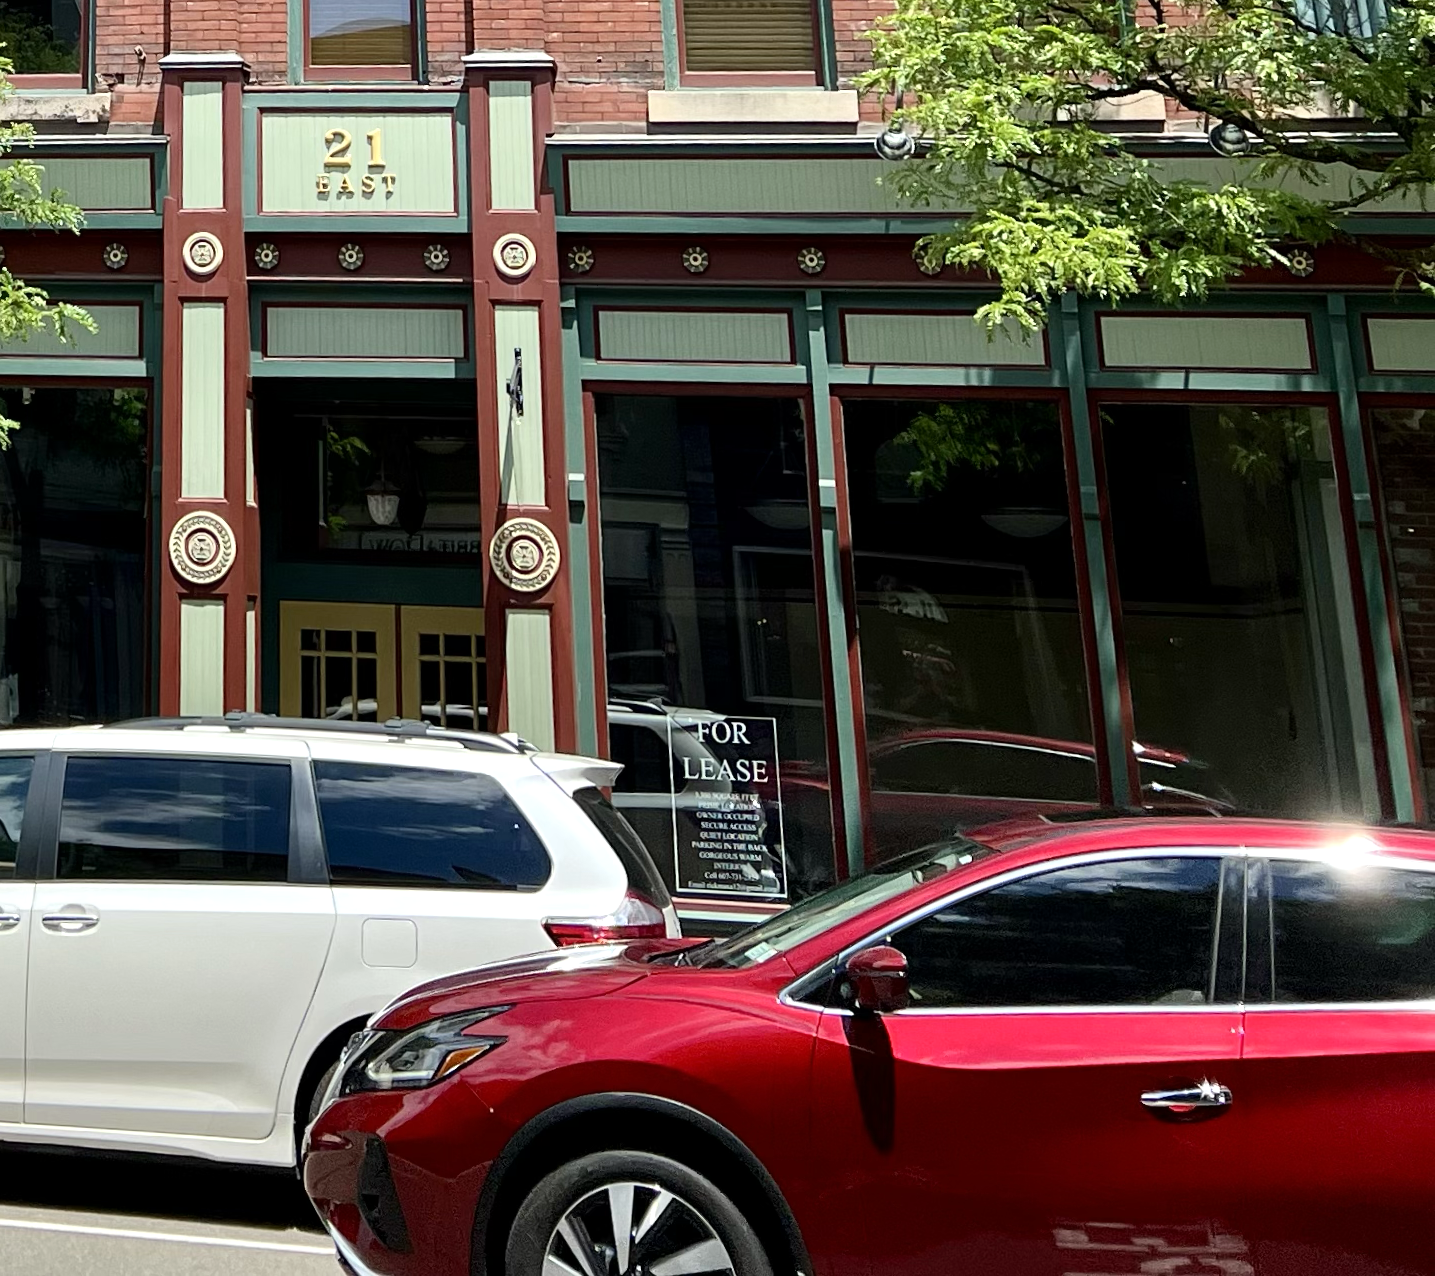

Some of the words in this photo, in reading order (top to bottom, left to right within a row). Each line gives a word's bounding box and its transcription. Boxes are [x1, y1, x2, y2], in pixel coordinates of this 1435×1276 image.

[323, 127, 387, 168] 21
[315, 173, 397, 194] EAST
[696, 720, 751, 745] FOR
[682, 756, 769, 784] LEASE
[696, 811, 723, 820] OWNER
[724, 812, 761, 822] OCCUPIED
[700, 821, 728, 830] SECURE
[729, 823, 757, 832] ACCESS
[699, 831, 722, 840] QUIET
[722, 831, 759, 841] LOCATION
[691, 840, 722, 849] PARKING
[733, 842, 747, 851] THE
[748, 843, 768, 852] BACK
[699, 851, 738, 860] GORGEOUS
[739, 852, 763, 861] WARM
[704, 871, 718, 879] Cell
